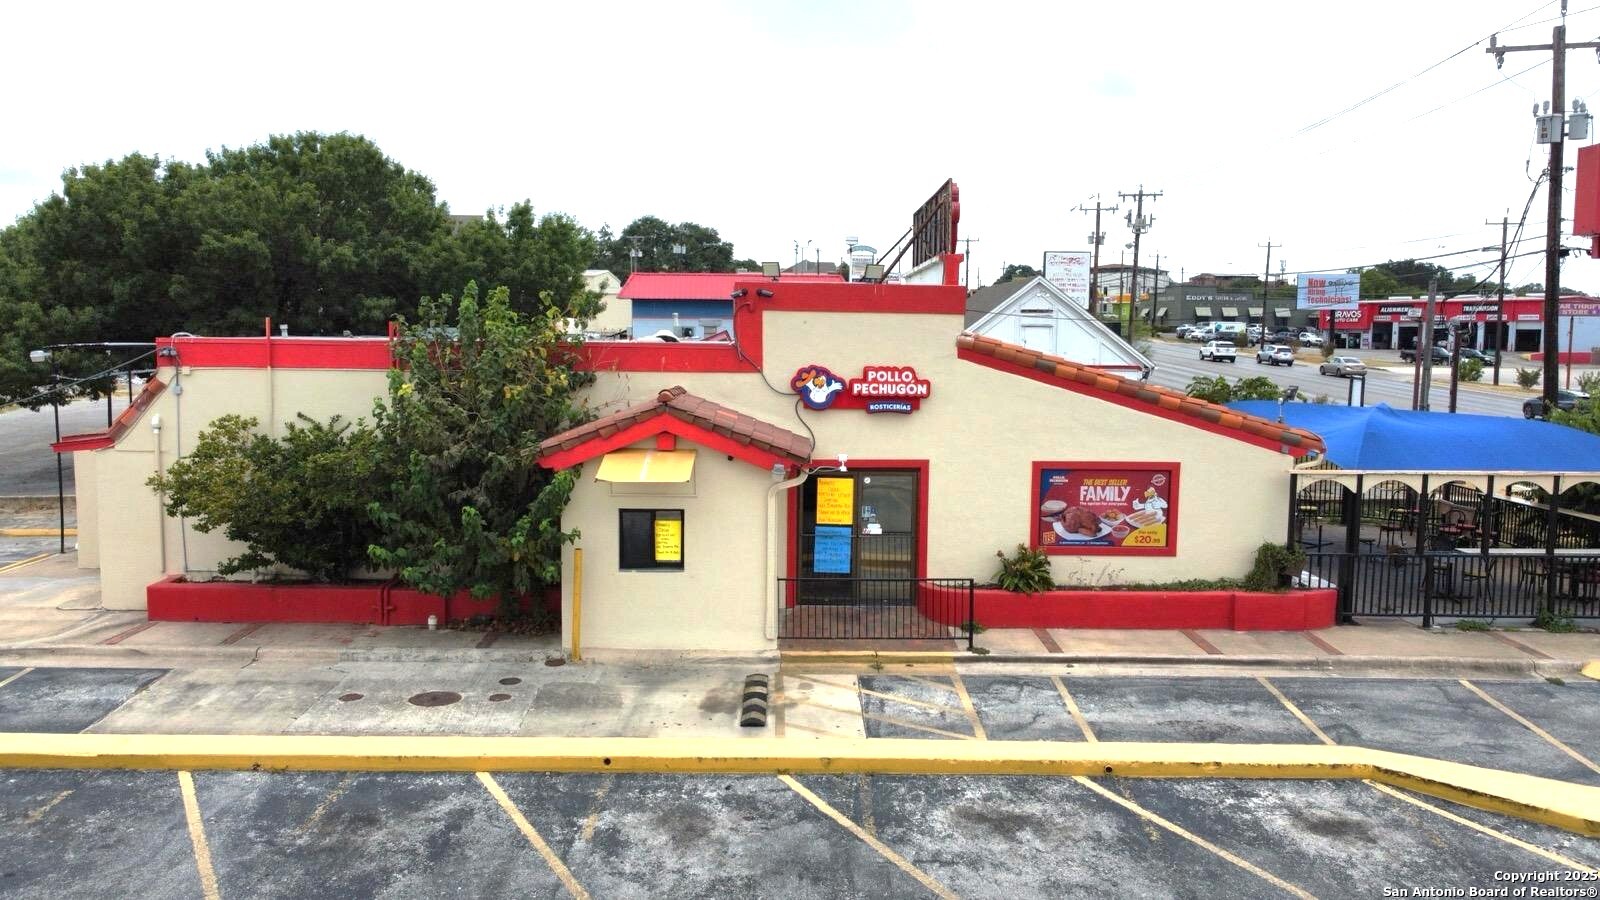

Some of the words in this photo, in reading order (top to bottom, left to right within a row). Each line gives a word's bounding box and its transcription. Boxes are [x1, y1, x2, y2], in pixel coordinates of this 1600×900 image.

[1308, 278, 1326, 287] Now
[868, 371, 912, 382] POLLO
[853, 380, 927, 394] PECHUGÓN
[870, 403, 911, 411] ROSTICERÍAS
[1080, 485, 1131, 502] FAMILY
